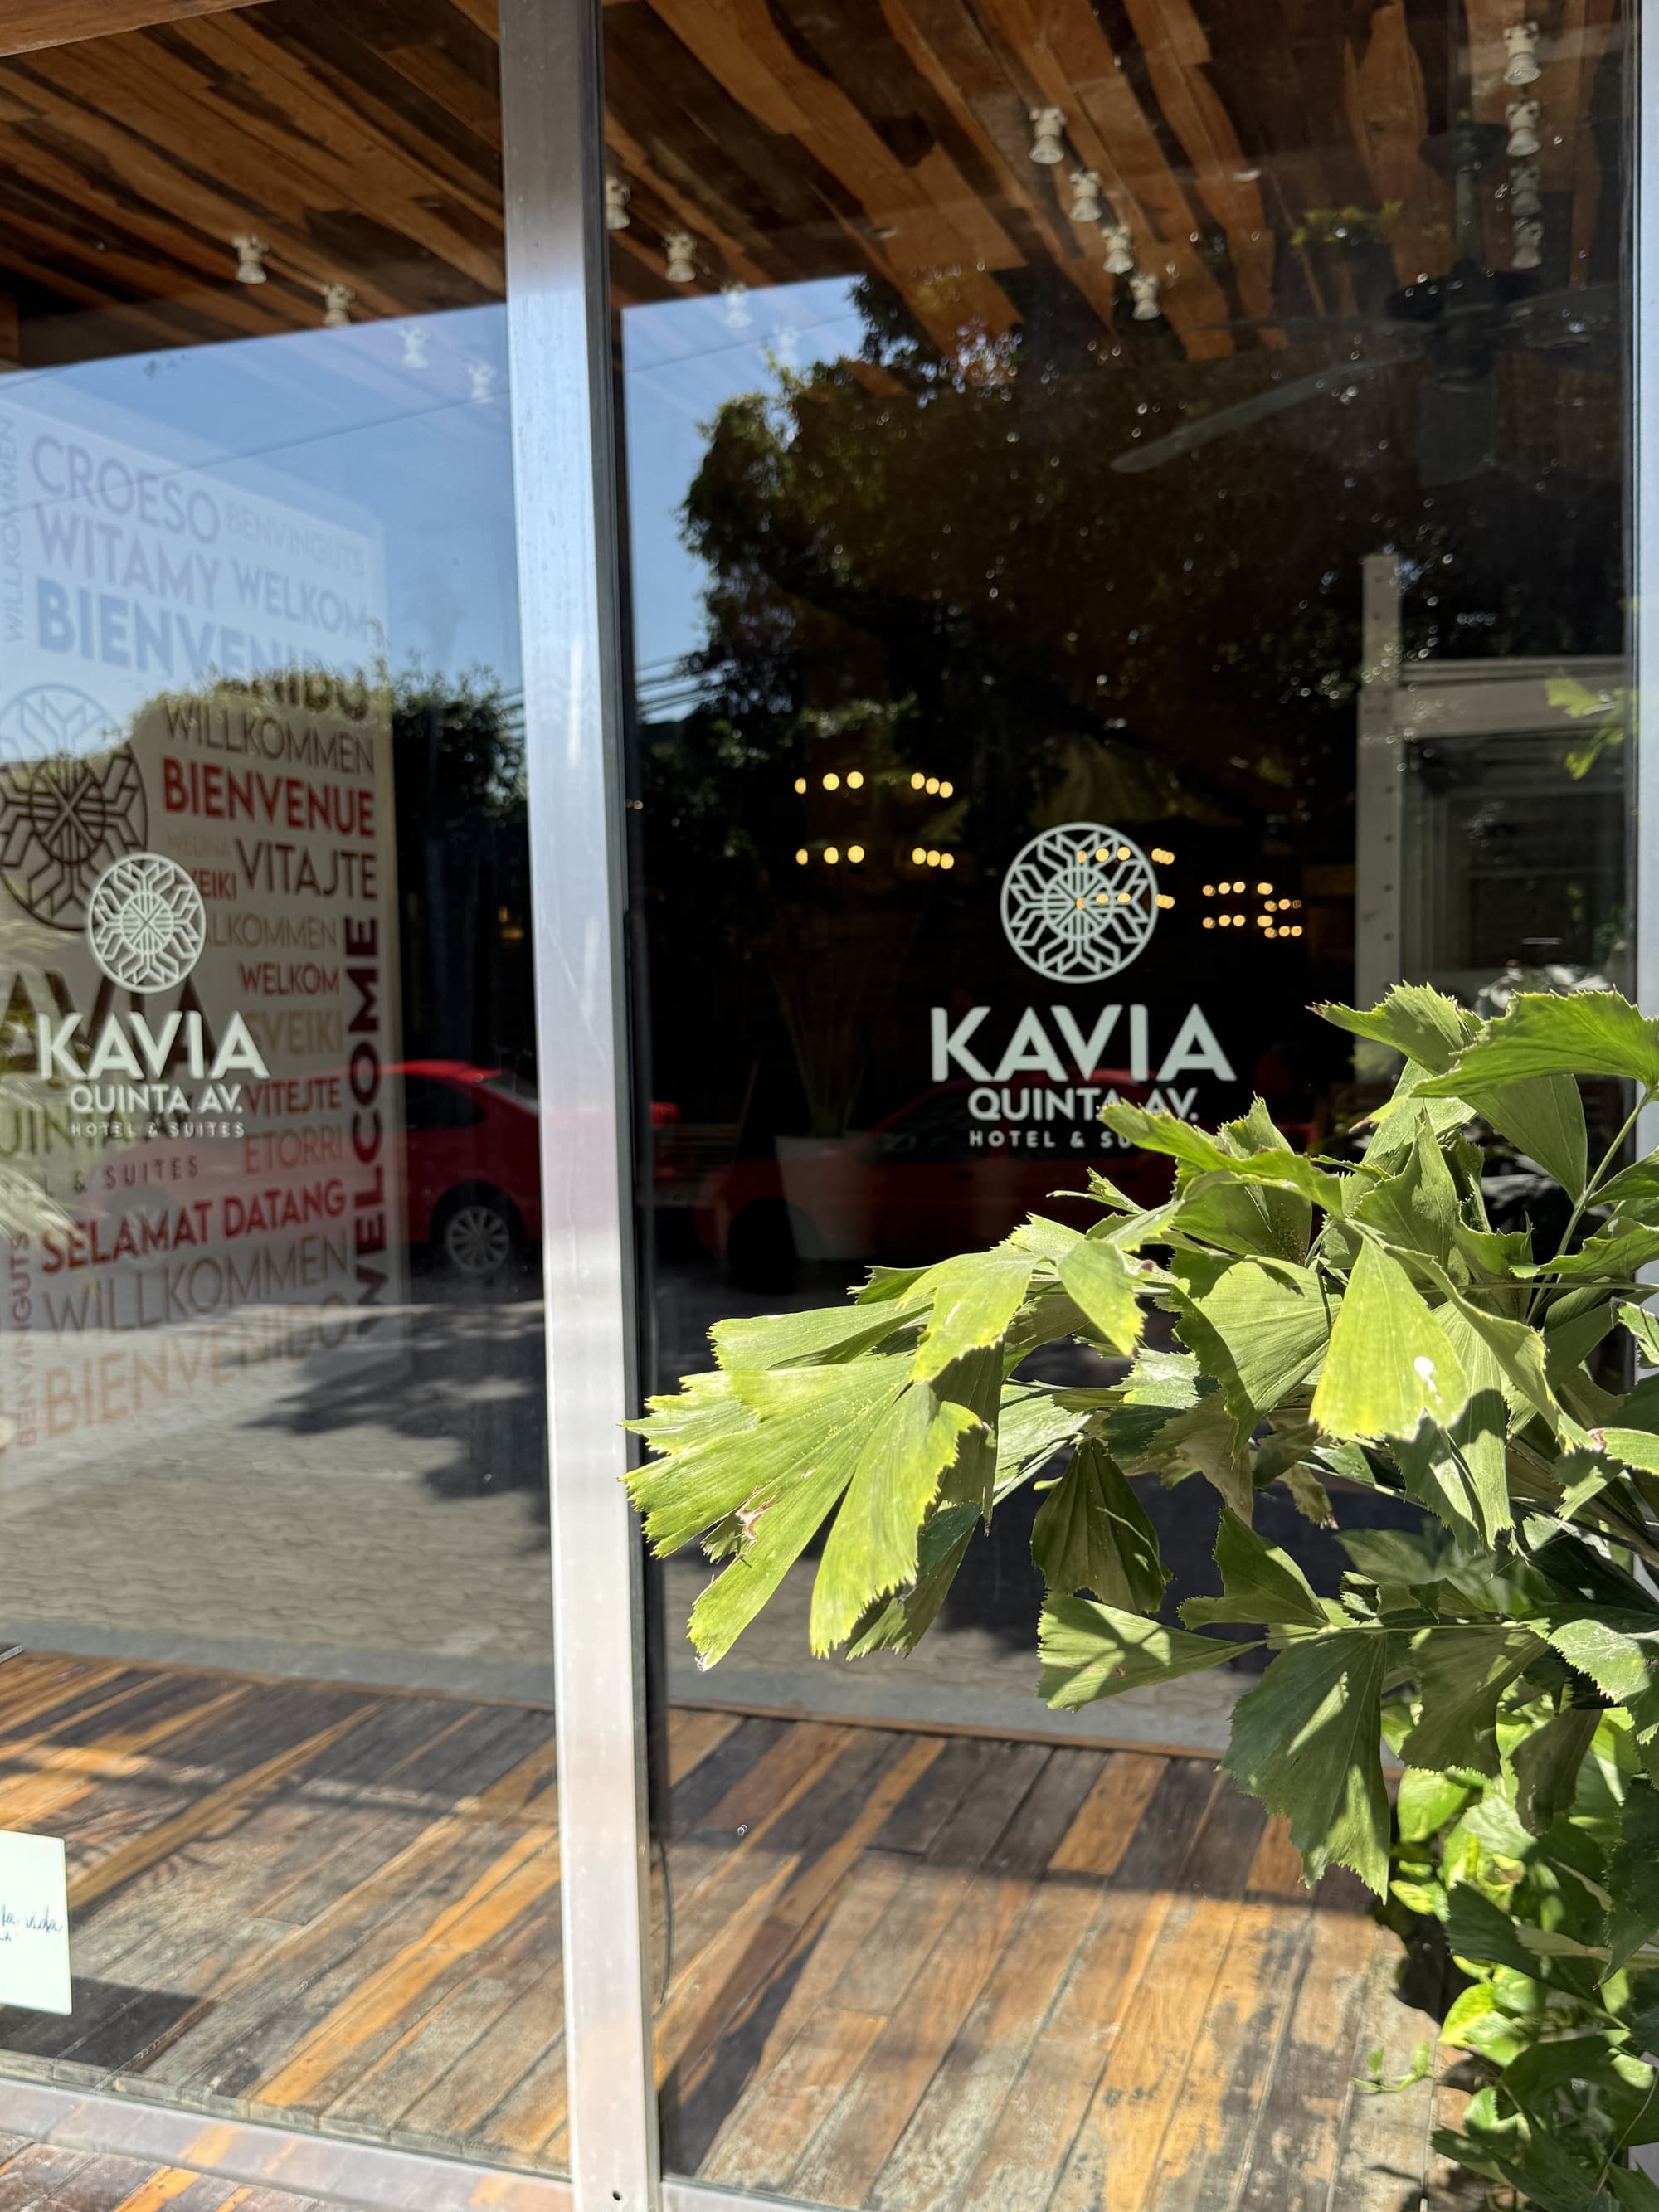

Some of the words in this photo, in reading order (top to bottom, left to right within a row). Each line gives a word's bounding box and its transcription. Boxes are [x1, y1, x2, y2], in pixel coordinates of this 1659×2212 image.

[32, 435, 220, 544] CROESO
[35, 502, 221, 612] WITAMY
[231, 556, 368, 641] WELKOM
[163, 702, 377, 775] WILLKOMMEN
[162, 756, 377, 838] BIENVENUE
[236, 837, 379, 901] VITAJTE
[239, 960, 340, 996] WELKOM
[36, 1009, 270, 1080] KAVIA
[930, 1004, 1238, 1083] KAVIA
[70, 1082, 192, 1115] QUINTA
[197, 1082, 244, 1115] AV.
[71, 1121, 137, 1139] HOTEL
[146, 1121, 159, 1138] &
[168, 1121, 246, 1139] SUITES
[245, 1076, 342, 1117] VITEJTE
[344, 915, 389, 1336] WELCOME
[105, 1155, 200, 1191] SUITES
[243, 1122, 343, 1175] ETORRI
[969, 1130, 1058, 1149] HOTEL
[1069, 1130, 1086, 1148] &
[41, 1200, 214, 1275] SELAMAT
[223, 1179, 348, 1239] DATANG
[42, 1229, 348, 1339] WILLKOMMEN
